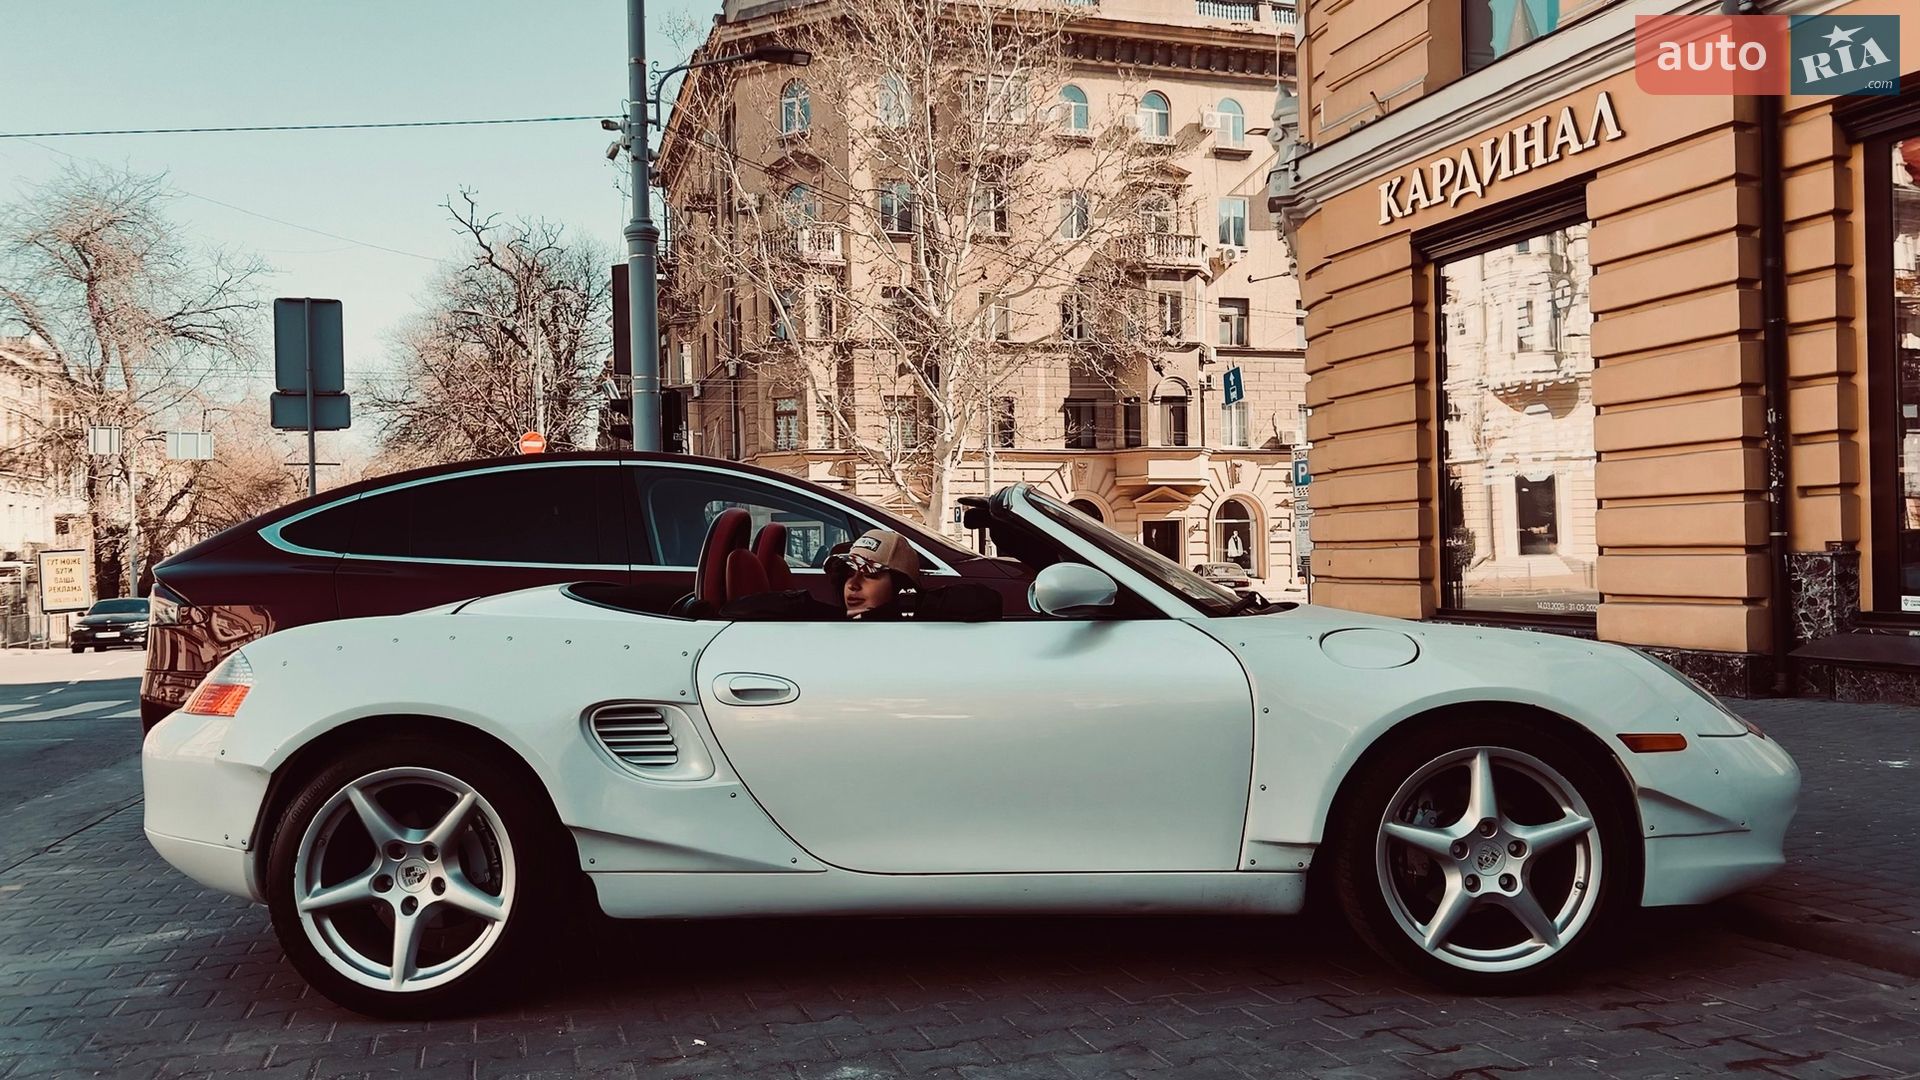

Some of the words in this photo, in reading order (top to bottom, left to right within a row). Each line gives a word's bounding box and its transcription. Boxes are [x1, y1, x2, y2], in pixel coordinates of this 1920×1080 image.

[1378, 91, 1624, 225] КАРДИНАЛ
[1298, 463, 1308, 483] P
[55, 567, 73, 575] БУТИ
